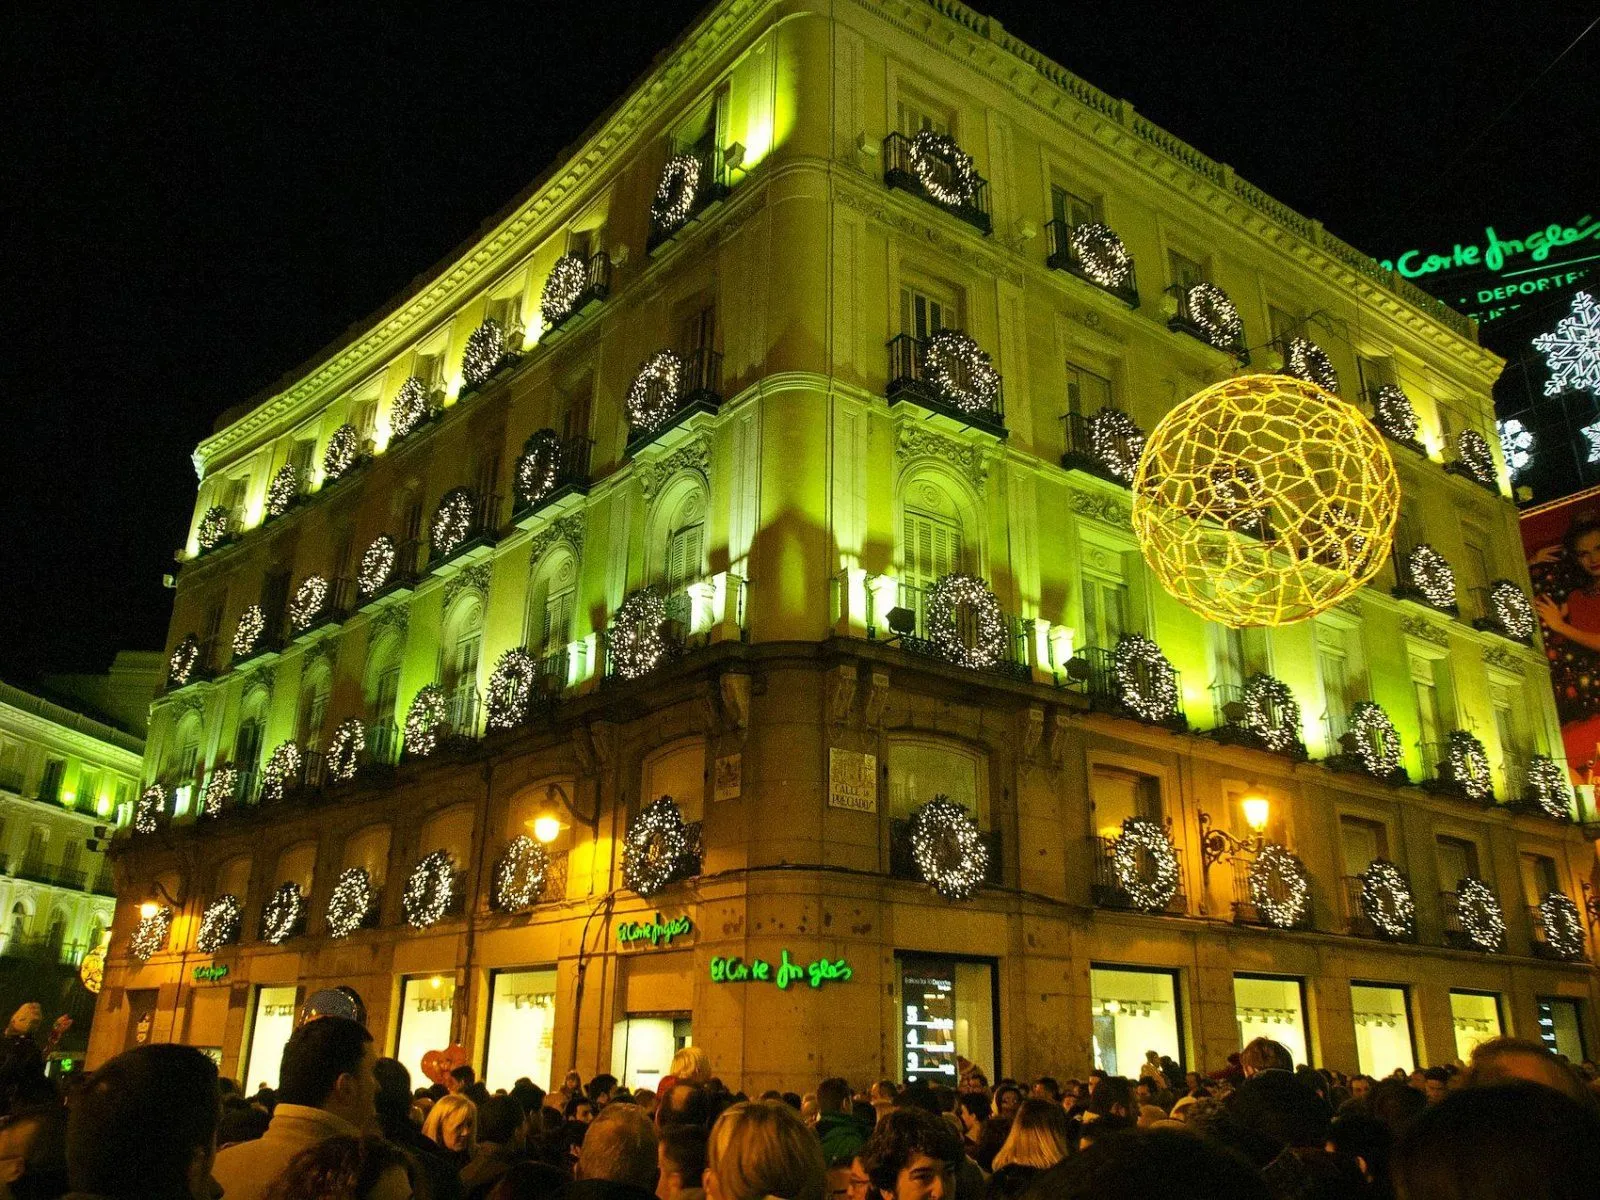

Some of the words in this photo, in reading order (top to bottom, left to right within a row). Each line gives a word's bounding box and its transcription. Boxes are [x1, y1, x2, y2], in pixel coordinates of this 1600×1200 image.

[1397, 244, 1480, 277] Corte
[711, 956, 725, 981] El
[725, 956, 769, 981] Corte
